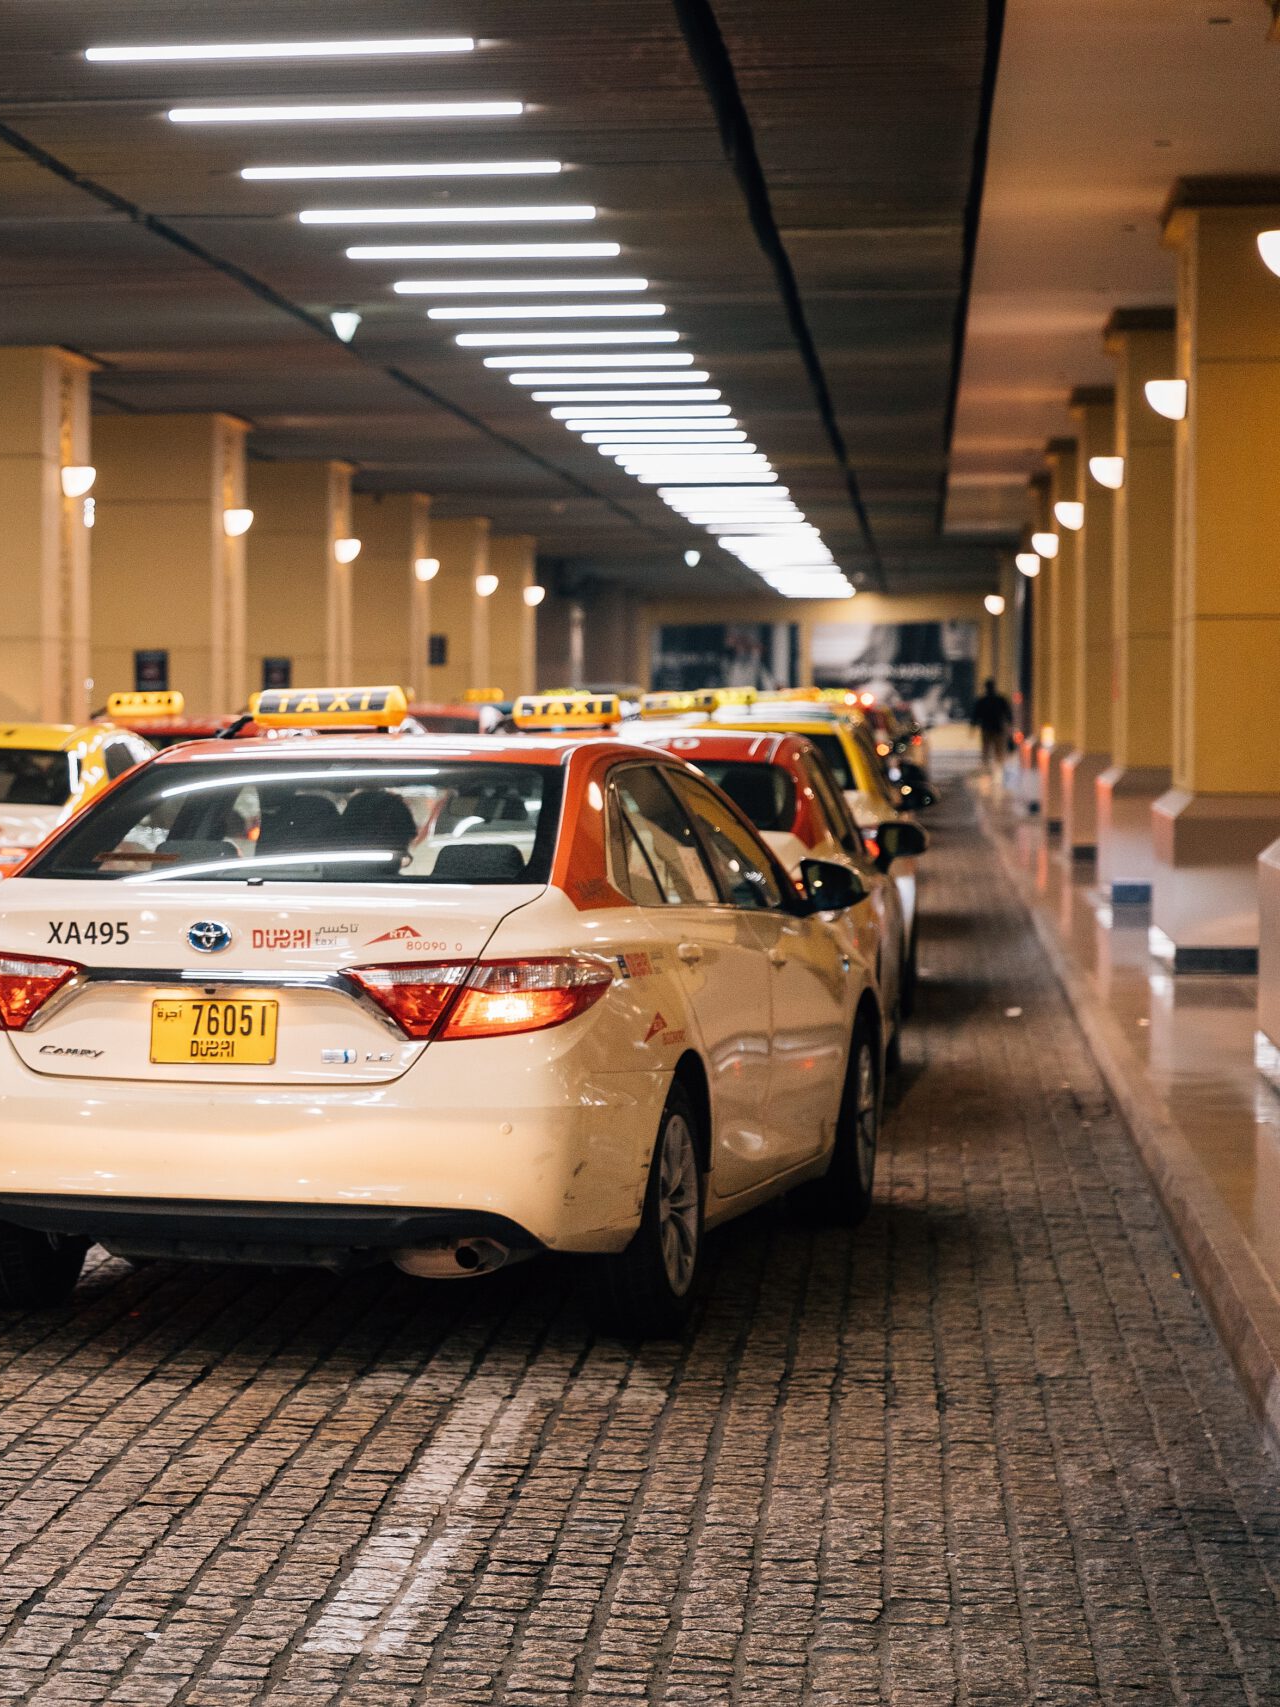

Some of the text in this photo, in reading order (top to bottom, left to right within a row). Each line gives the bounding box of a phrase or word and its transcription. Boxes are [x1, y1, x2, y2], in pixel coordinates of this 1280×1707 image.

[276, 692, 372, 713] TAXI
[533, 702, 602, 717] TAXI
[47, 921, 130, 945] XA495
[315, 924, 360, 936] تاكسي
[387, 929, 412, 939] RTA
[252, 929, 311, 950] DUBAI
[315, 936, 338, 946] taxi
[157, 1004, 183, 1022] أجرة
[192, 1004, 268, 1036] 76051
[190, 1040, 235, 1058] DUBAI
